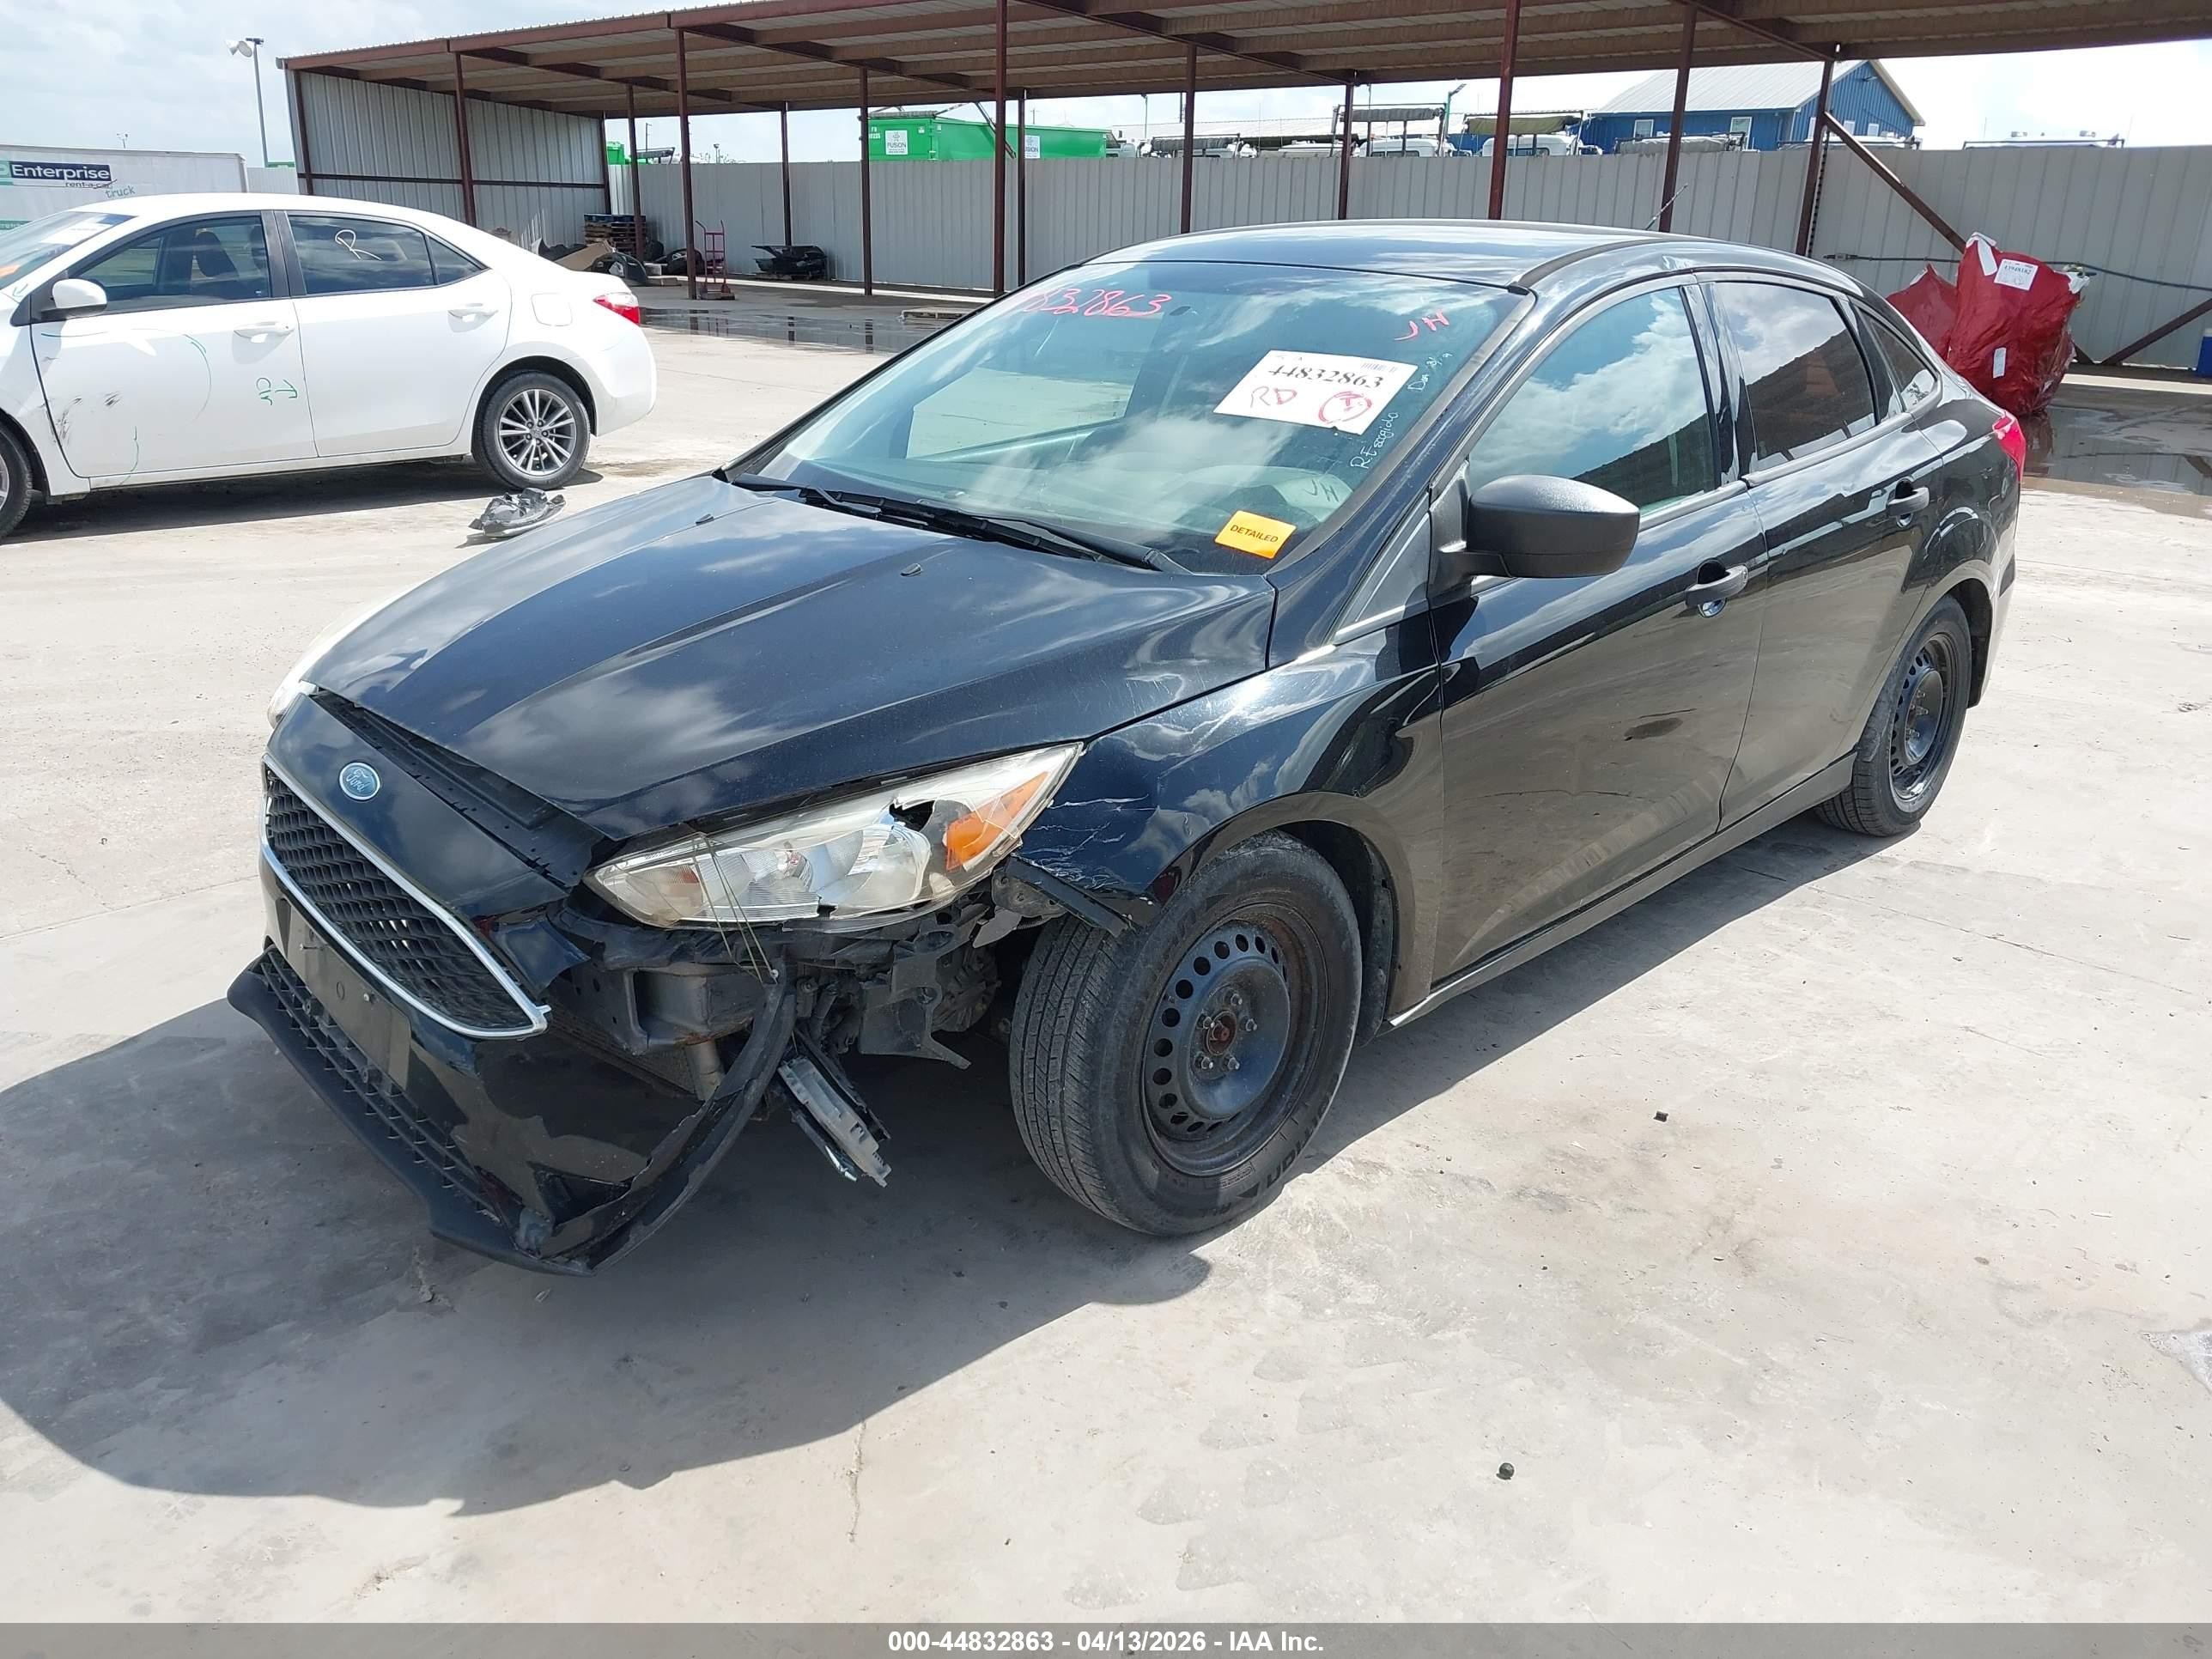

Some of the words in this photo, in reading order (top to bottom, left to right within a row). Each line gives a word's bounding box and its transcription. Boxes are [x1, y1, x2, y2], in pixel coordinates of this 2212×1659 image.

[11, 163, 110, 179] Enterprise
[104, 185, 136, 198] truck
[1267, 364, 1384, 389] 44832863
[1230, 524, 1279, 544] DETAILED
